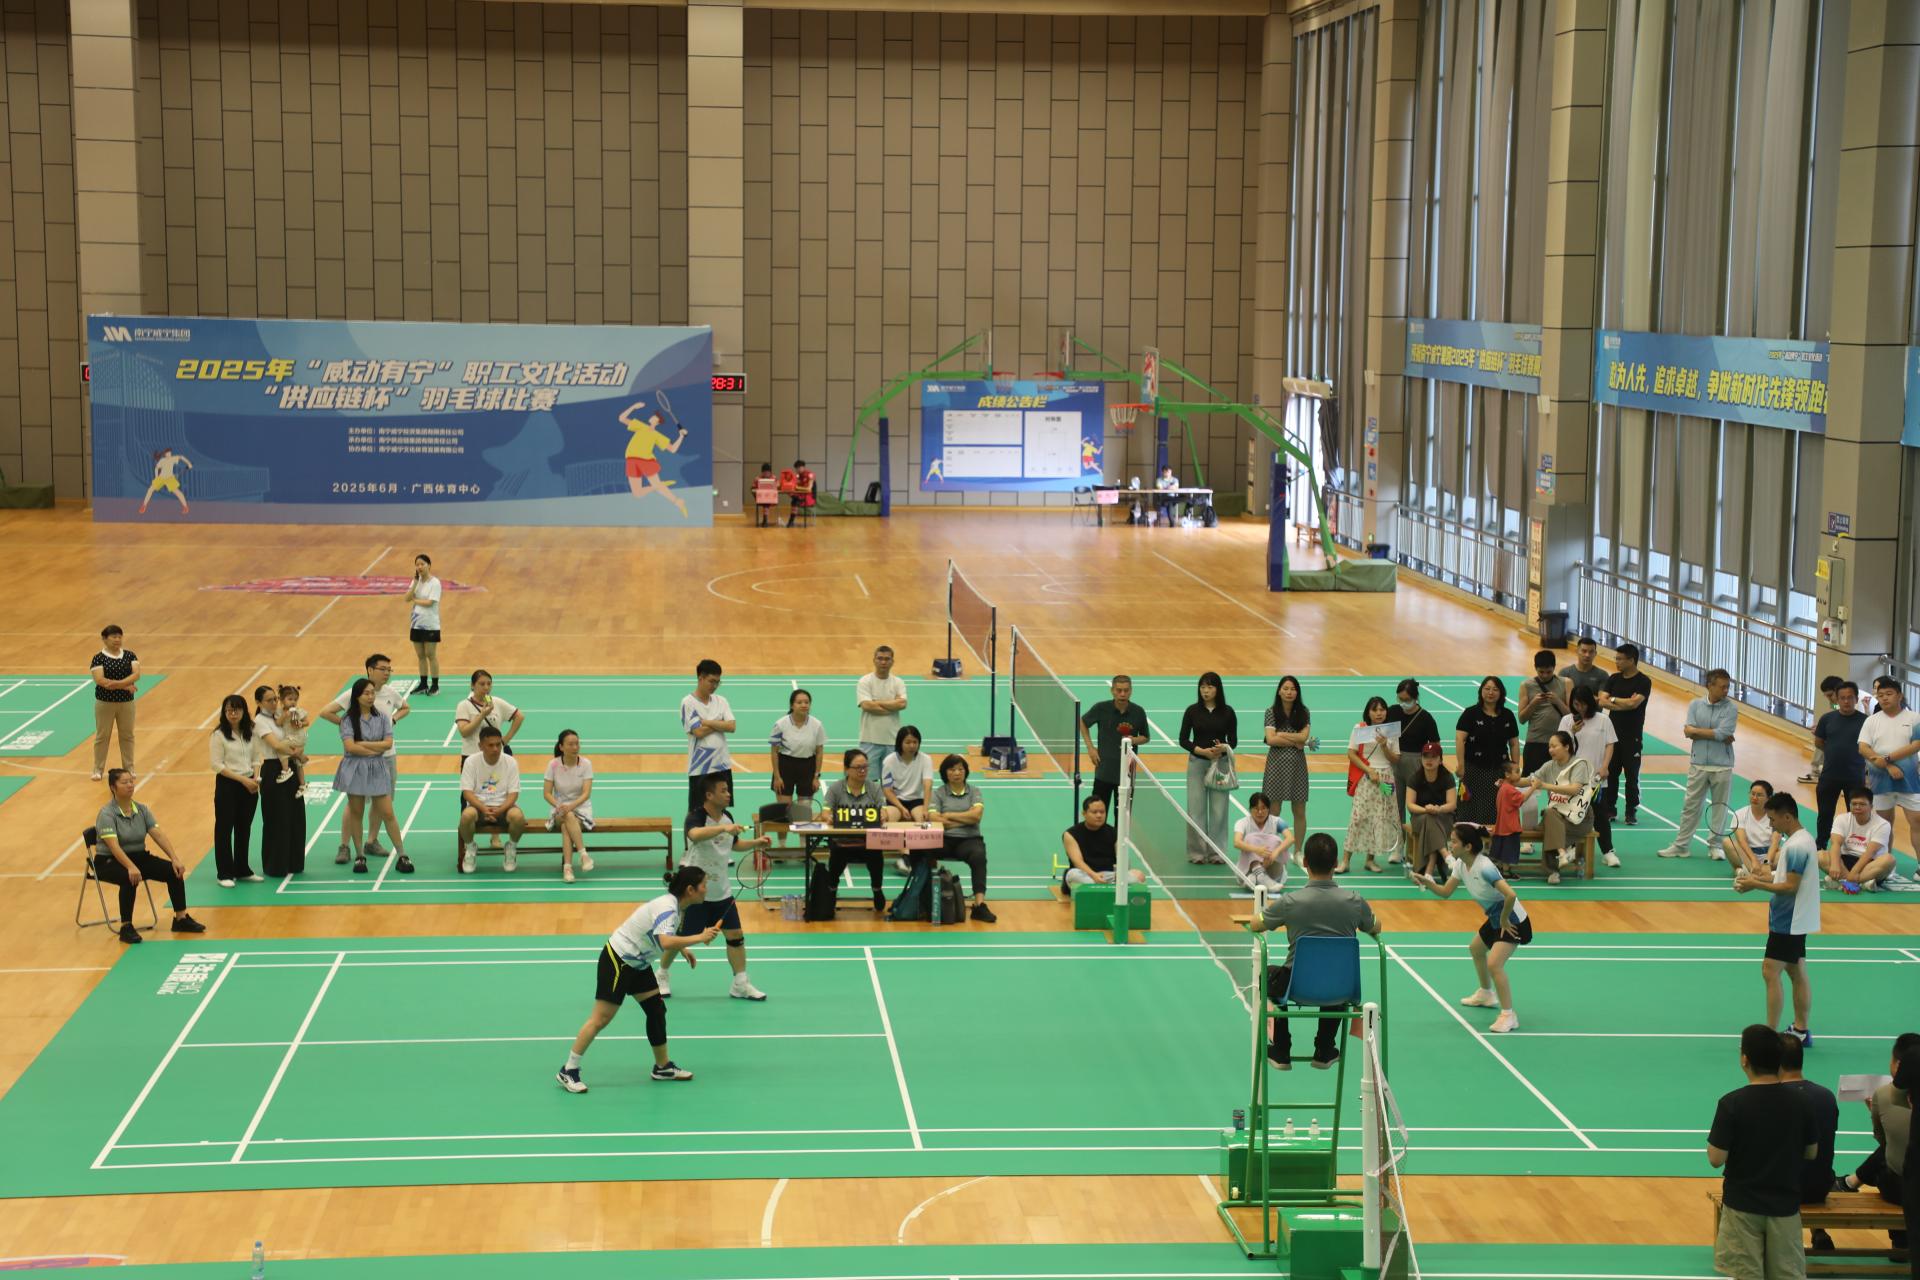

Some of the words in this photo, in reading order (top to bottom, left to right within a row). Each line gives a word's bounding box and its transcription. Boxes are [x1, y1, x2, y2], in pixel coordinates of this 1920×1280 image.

[1608, 361, 1829, 414] 敢为人先，追求卓越，争做新时代先锋领跑
[978, 396, 1047, 408] 成绩公告栏
[837, 808, 850, 822] 11
[866, 808, 877, 821] 9
